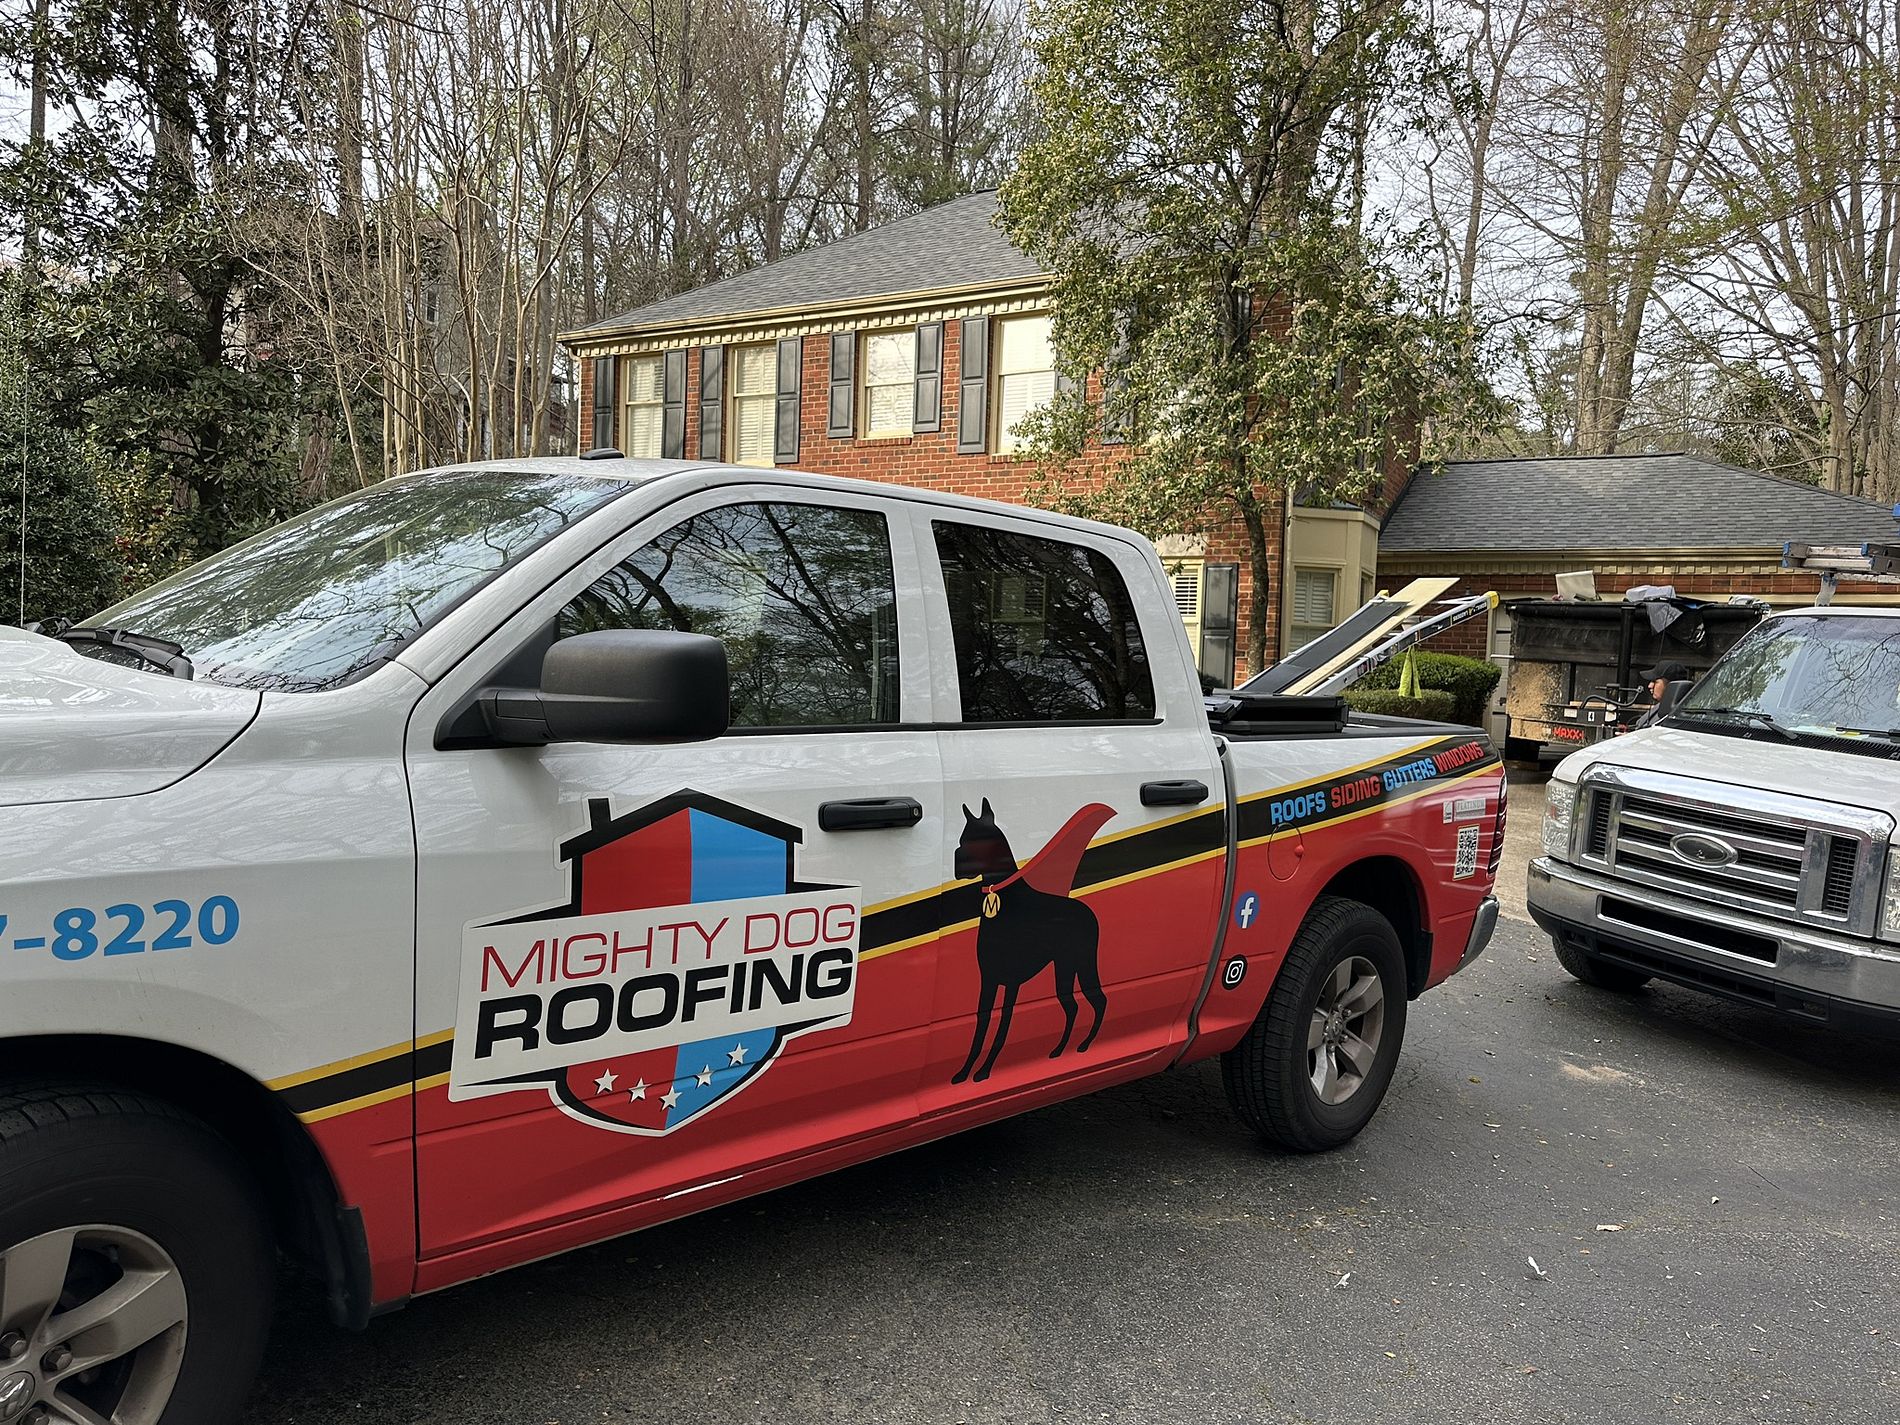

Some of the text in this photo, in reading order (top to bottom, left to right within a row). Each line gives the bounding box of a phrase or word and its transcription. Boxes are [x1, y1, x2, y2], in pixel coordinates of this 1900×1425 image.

[1270, 741, 1484, 825] ROOFS SIDING GUTTERS WINDOWS
[0, 895, 240, 961] -8220
[985, 895, 1000, 914] M
[1241, 897, 1255, 929] f
[481, 903, 856, 992] MIGHTY DOG
[474, 947, 853, 1060] ROOFING
